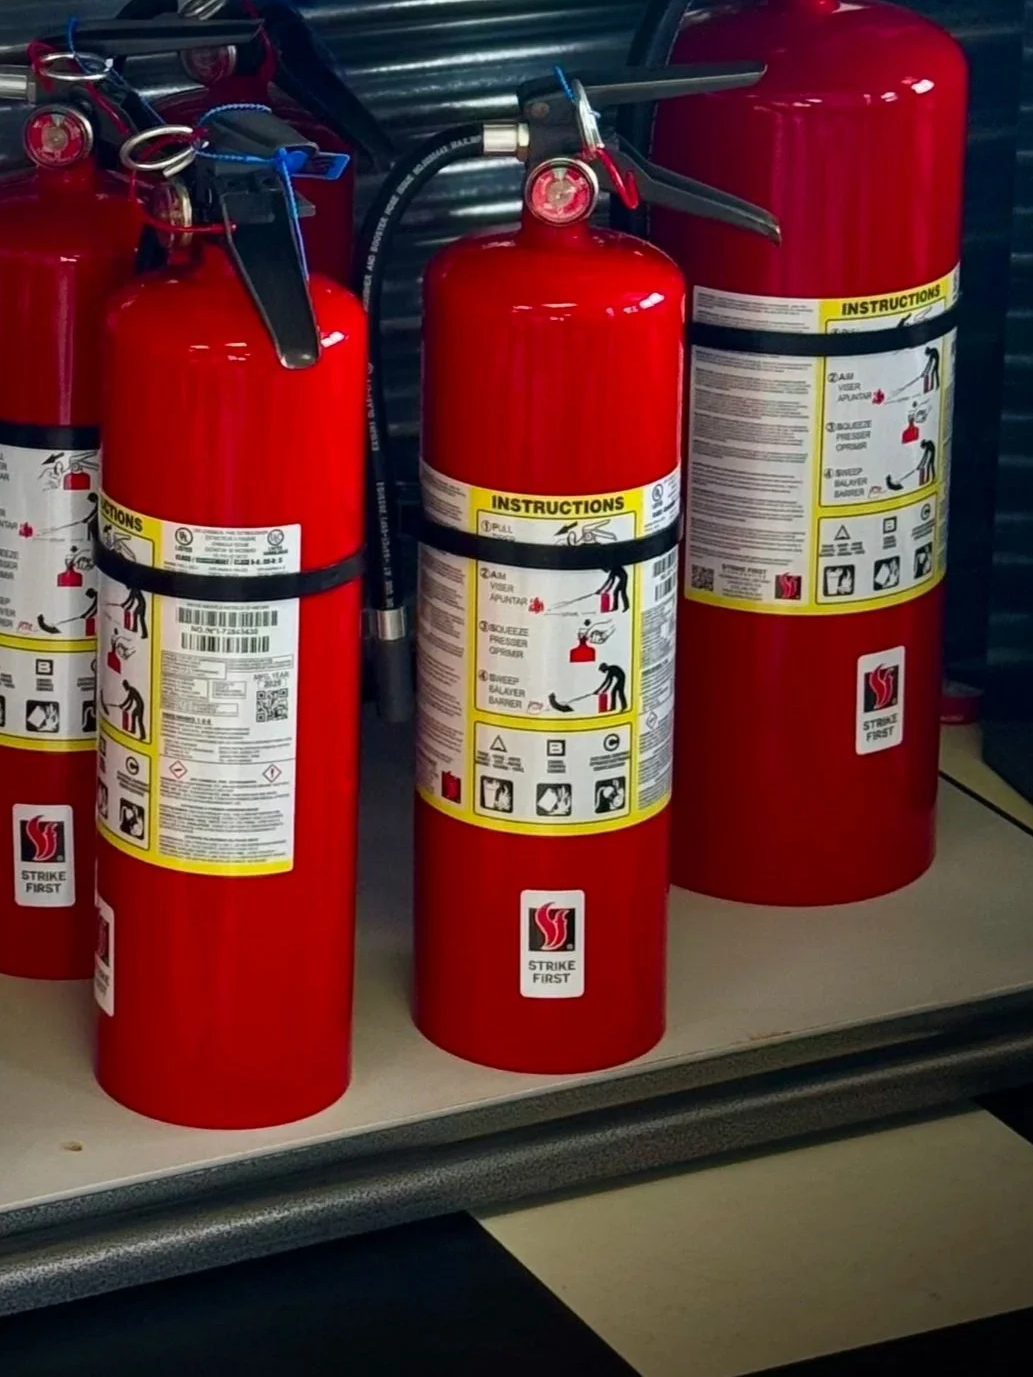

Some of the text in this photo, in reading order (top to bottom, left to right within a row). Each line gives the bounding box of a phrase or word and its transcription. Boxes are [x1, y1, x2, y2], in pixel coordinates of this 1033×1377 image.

[841, 285, 941, 316] INSTRUCTIONS
[838, 382, 861, 391] VISER
[836, 420, 873, 431] SQUEEZE
[836, 430, 872, 441] PRESSER
[835, 467, 864, 477] SWEEP
[834, 477, 868, 488] BALAYER
[834, 488, 865, 499] BARRER
[492, 495, 625, 515] INSTRUCTIONS
[492, 523, 513, 534] PULL
[490, 571, 506, 580] AIM
[489, 582, 514, 593] VISER
[489, 594, 528, 606] APUNTAR
[489, 624, 529, 637] SQUEEZE
[489, 635, 528, 648] PRESSER
[489, 673, 520, 686] SWEEP
[488, 685, 526, 698] BALAYER
[488, 696, 523, 709] BARRER
[863, 713, 898, 731] STRIKE
[866, 727, 894, 742] FIRST
[21, 870, 67, 882] STRIKE
[25, 883, 62, 894] FIRST
[528, 960, 576, 972] STRIKE
[532, 973, 571, 984] FIRST
